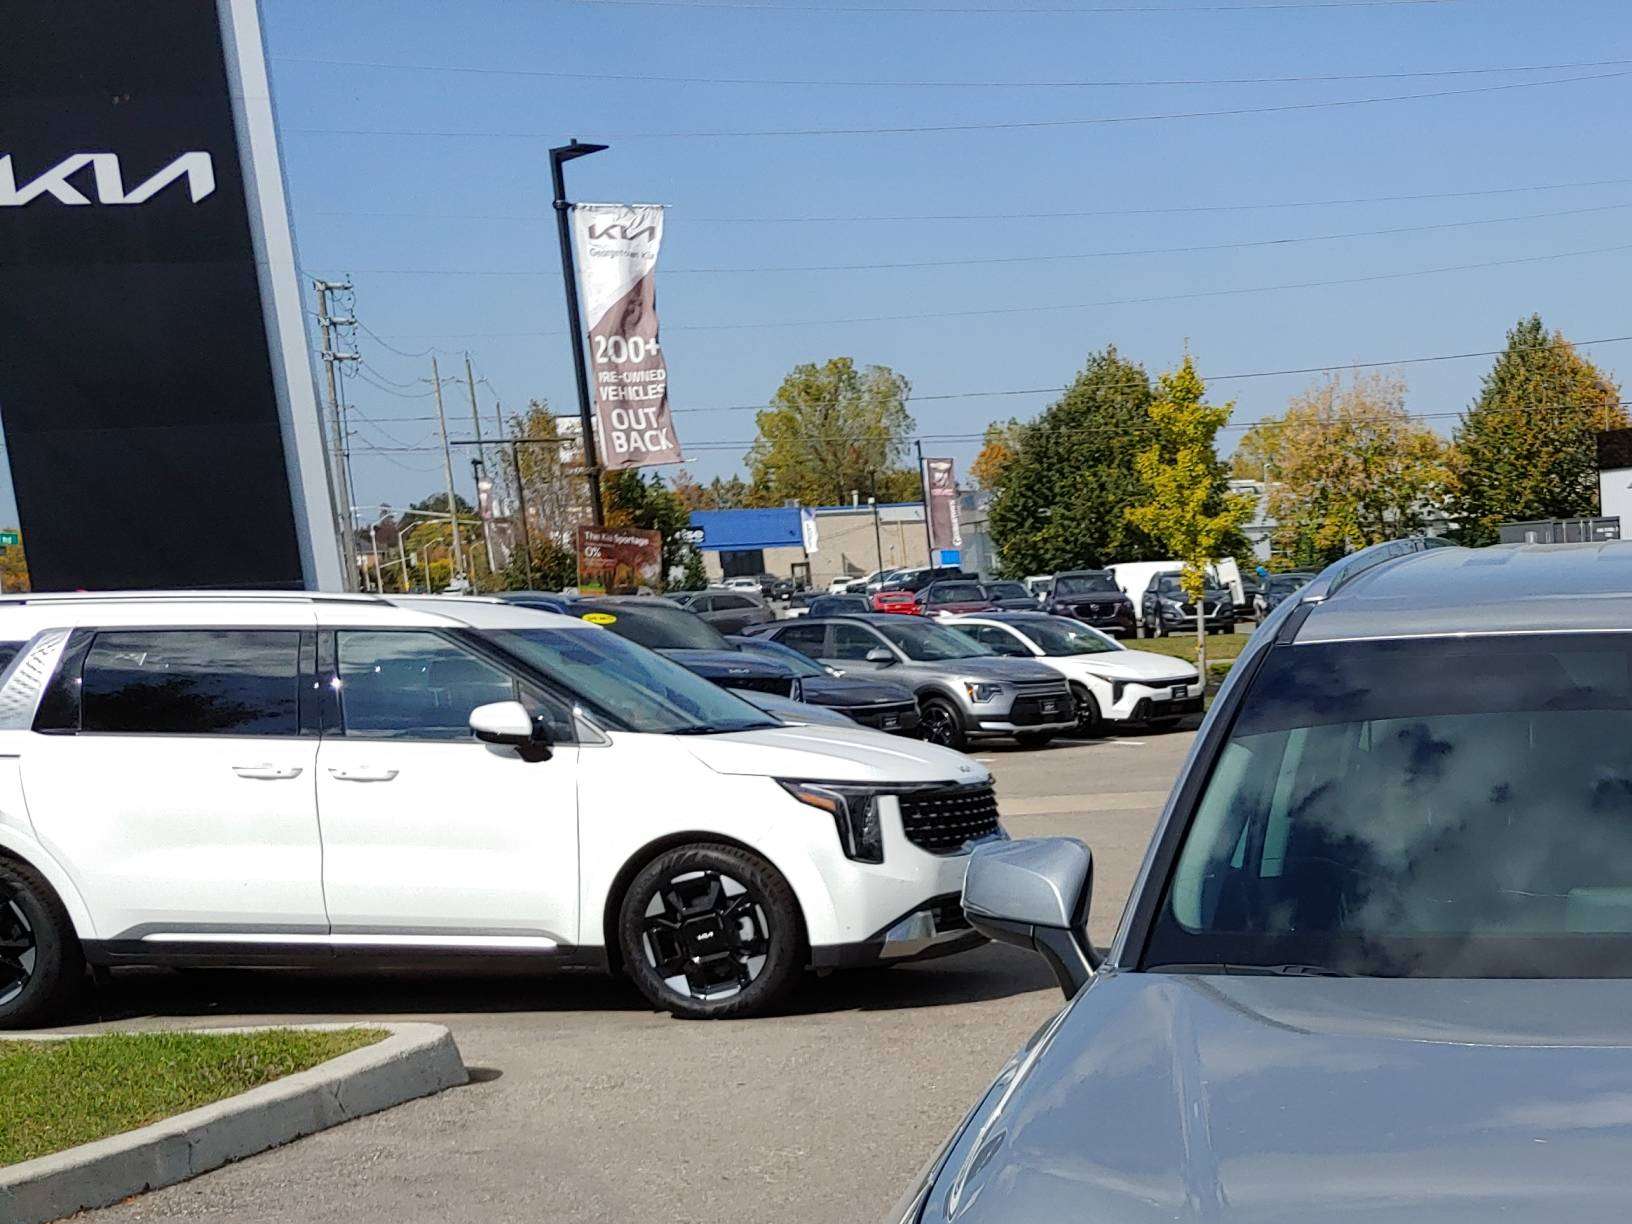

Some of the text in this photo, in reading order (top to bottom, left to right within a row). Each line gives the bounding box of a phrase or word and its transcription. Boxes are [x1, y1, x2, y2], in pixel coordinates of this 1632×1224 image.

[0, 152, 216, 206] KIA
[588, 224, 655, 243] KIA
[594, 335, 660, 364] 200+
[599, 384, 666, 401] VEHICLES
[611, 407, 658, 430] OUT
[612, 428, 674, 453] BACK
[585, 531, 601, 541] The
[614, 534, 650, 547] Sportage
[584, 546, 602, 558] 0%
